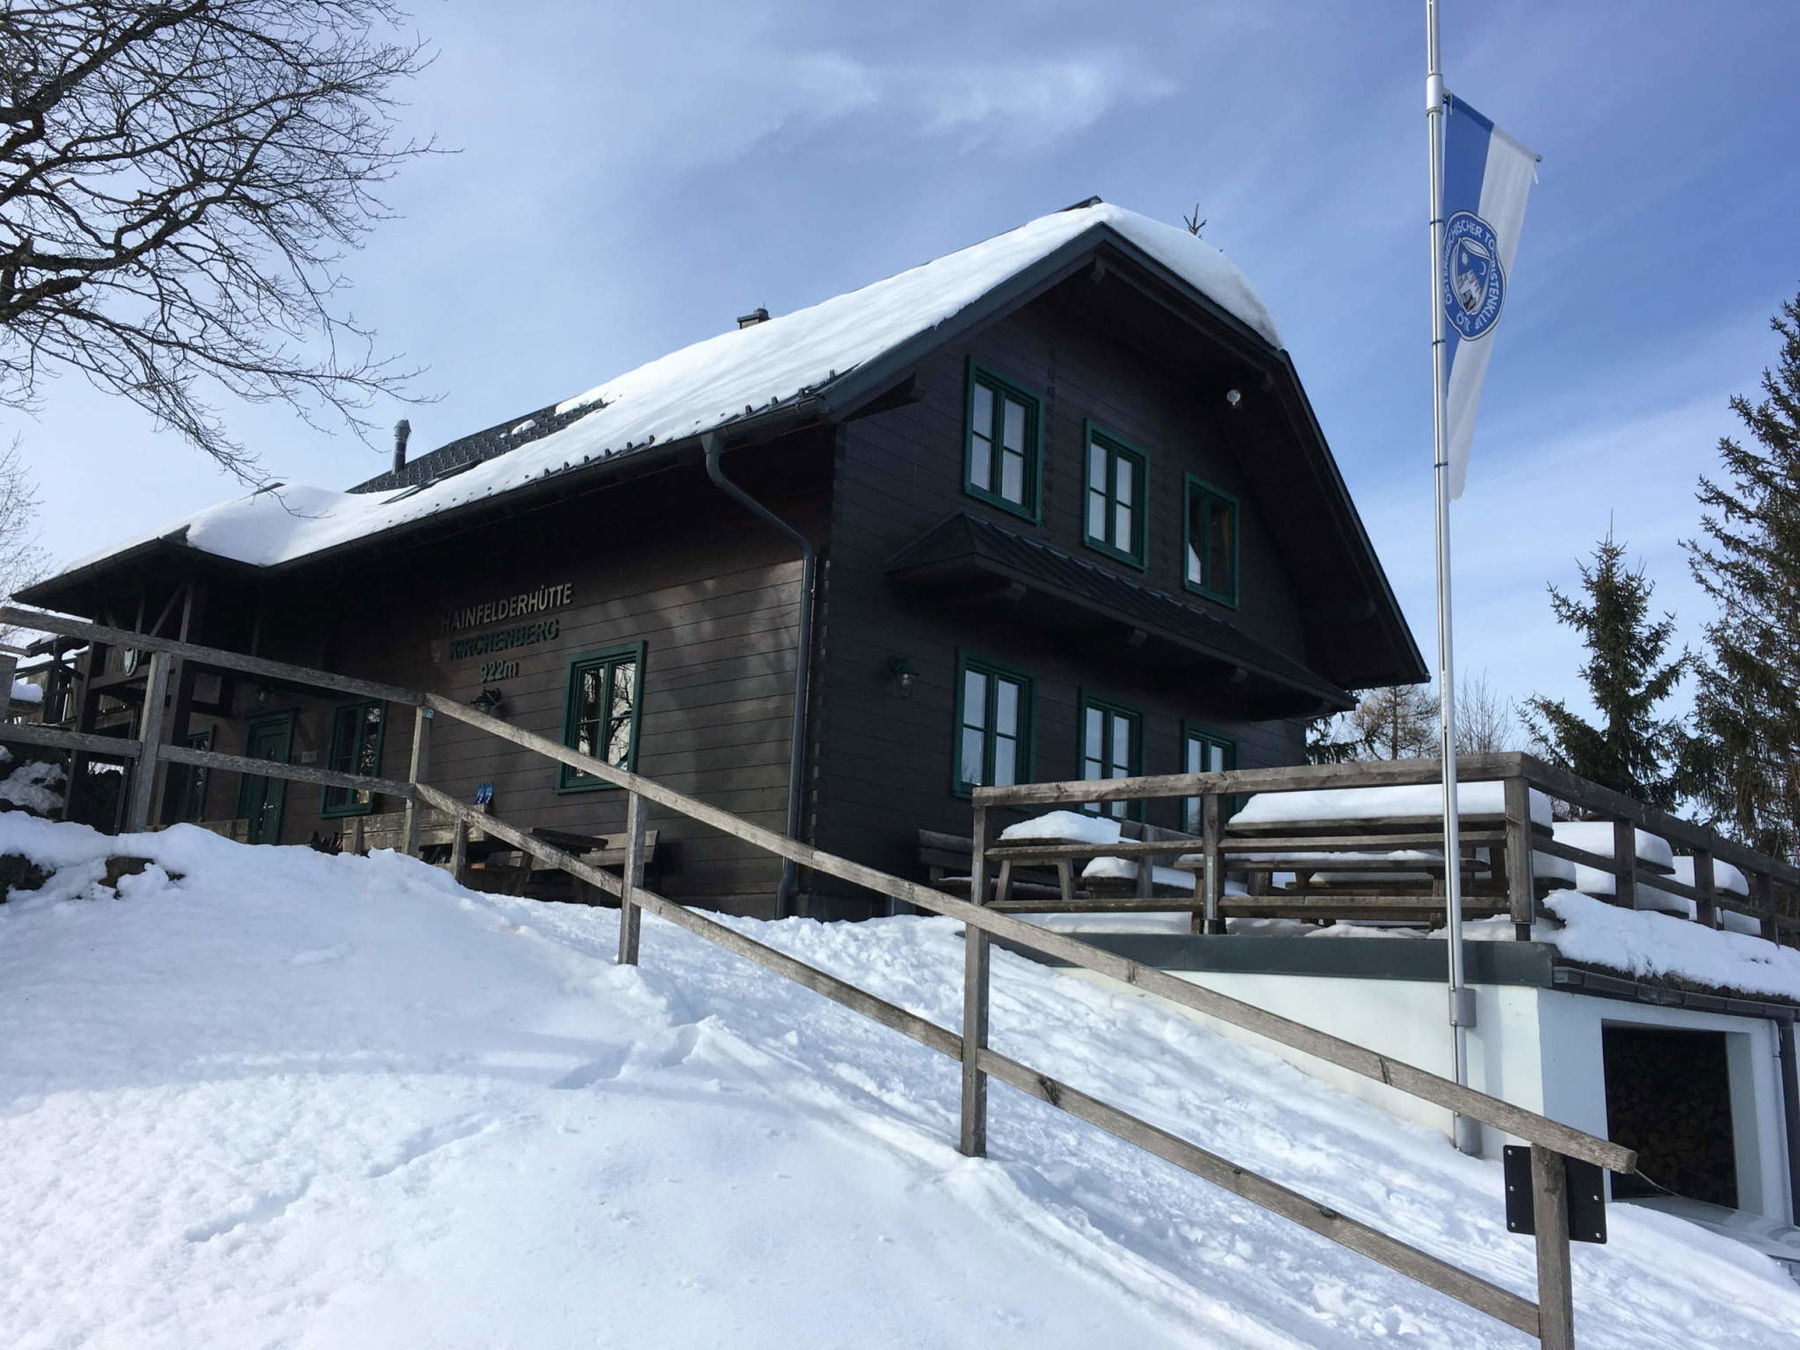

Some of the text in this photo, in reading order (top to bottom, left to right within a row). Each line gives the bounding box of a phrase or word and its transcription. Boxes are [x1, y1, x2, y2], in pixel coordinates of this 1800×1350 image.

[441, 583, 573, 632] HAINFELDERHÜTTE
[449, 618, 559, 660] KIRCHENBERG
[480, 660, 519, 682] 922m
